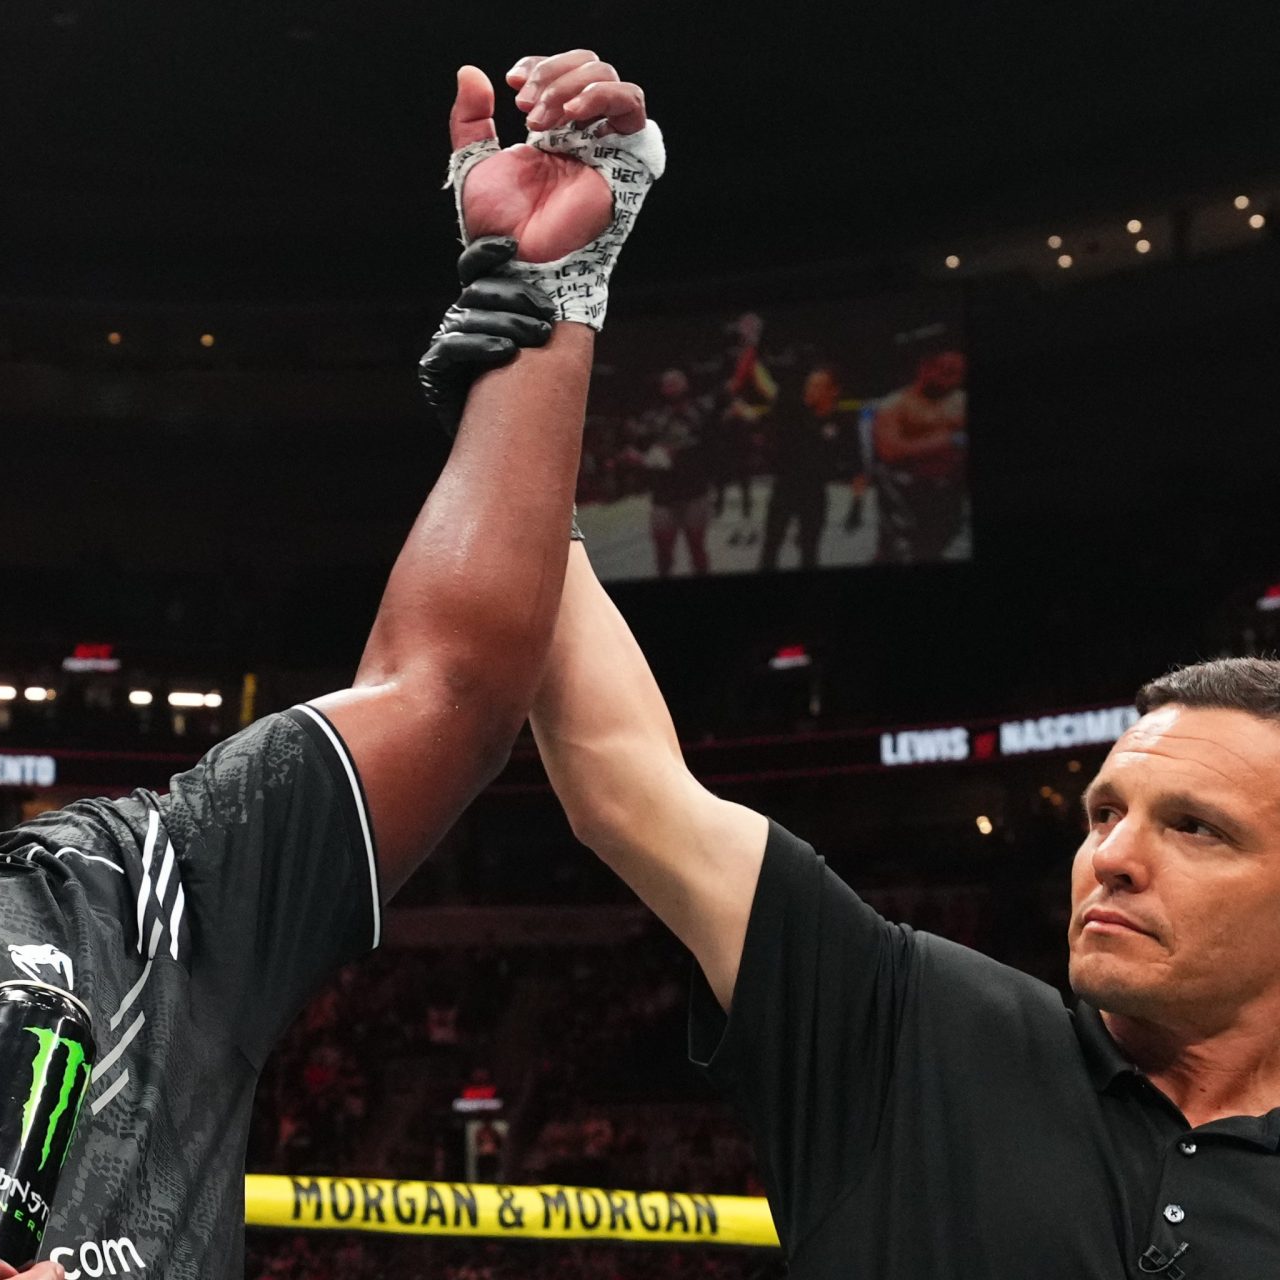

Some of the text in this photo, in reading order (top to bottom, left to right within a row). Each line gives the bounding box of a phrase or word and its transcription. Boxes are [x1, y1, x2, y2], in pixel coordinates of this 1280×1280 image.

[880, 726, 969, 766] LEWIS
[290, 1177, 720, 1235] MORGAN & MORGAN
[50, 1237, 146, 1280] com
